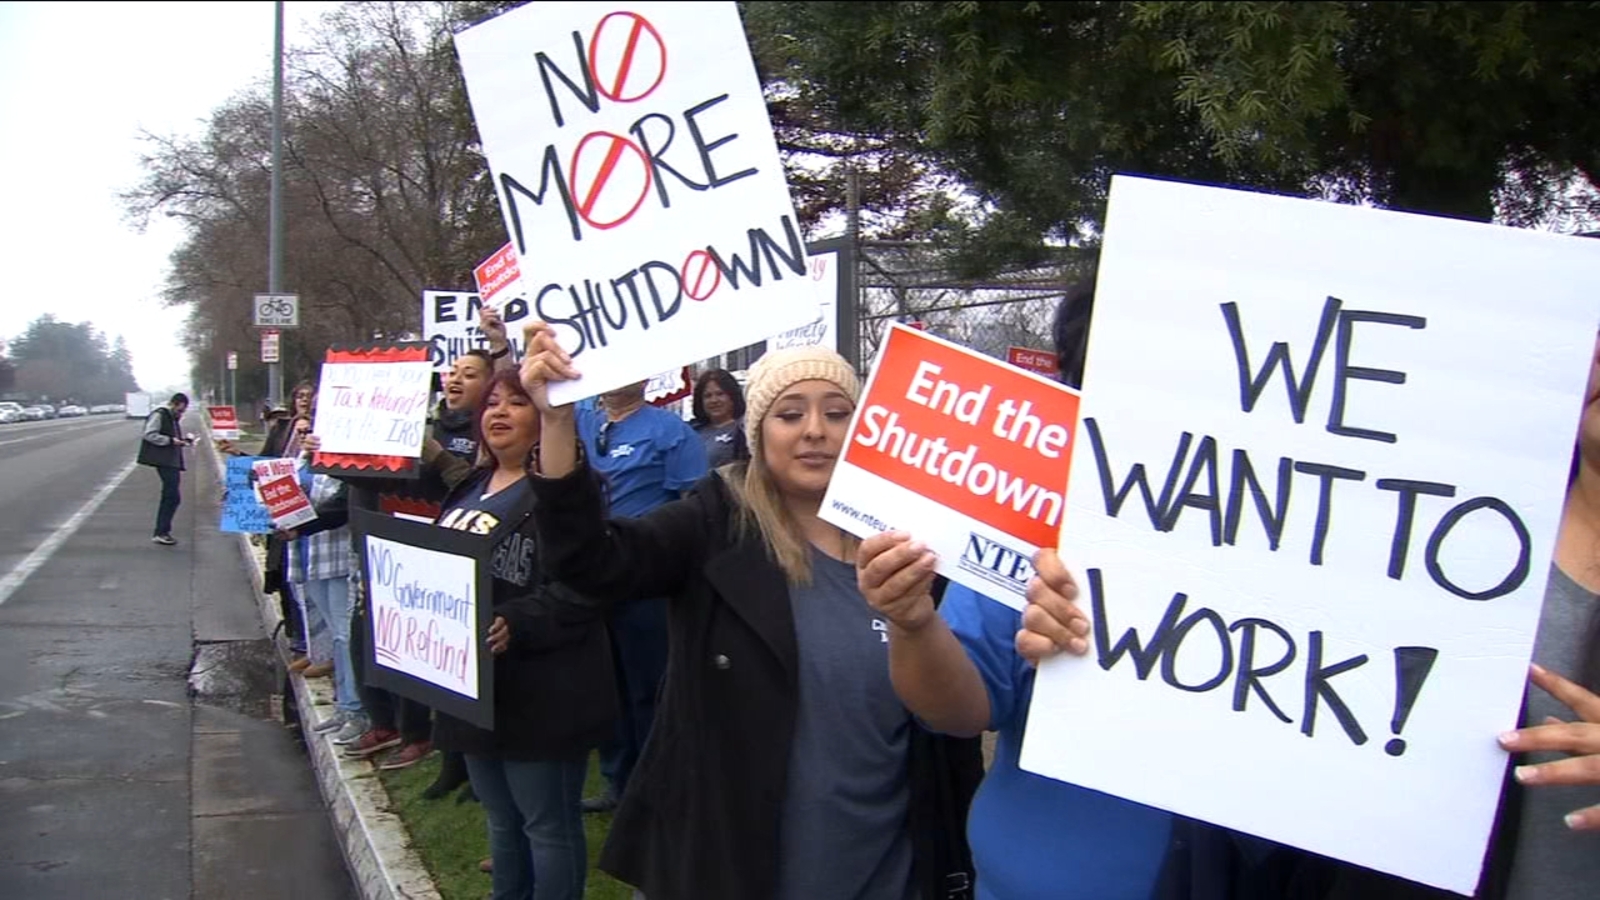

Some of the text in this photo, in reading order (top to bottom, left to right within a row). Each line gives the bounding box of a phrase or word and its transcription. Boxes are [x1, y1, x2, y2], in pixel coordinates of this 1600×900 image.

[535, 11, 667, 127] NO
[500, 93, 759, 255] MORE
[535, 215, 807, 358] SHUTDOWN
[331, 386, 365, 407] Tax
[646, 371, 675, 393] IRS
[1016, 353, 1034, 365] End
[1220, 296, 1426, 443] WE
[382, 418, 422, 448] IRS
[905, 360, 1068, 459] End the
[855, 405, 1066, 527] Shutdown
[1084, 417, 1531, 601] WANT TO
[831, 498, 896, 532] www.nteu
[961, 533, 1031, 584] NTE
[370, 543, 474, 630] NO Government
[377, 605, 470, 685] NO Refund
[1087, 567, 1439, 757] WORK!
